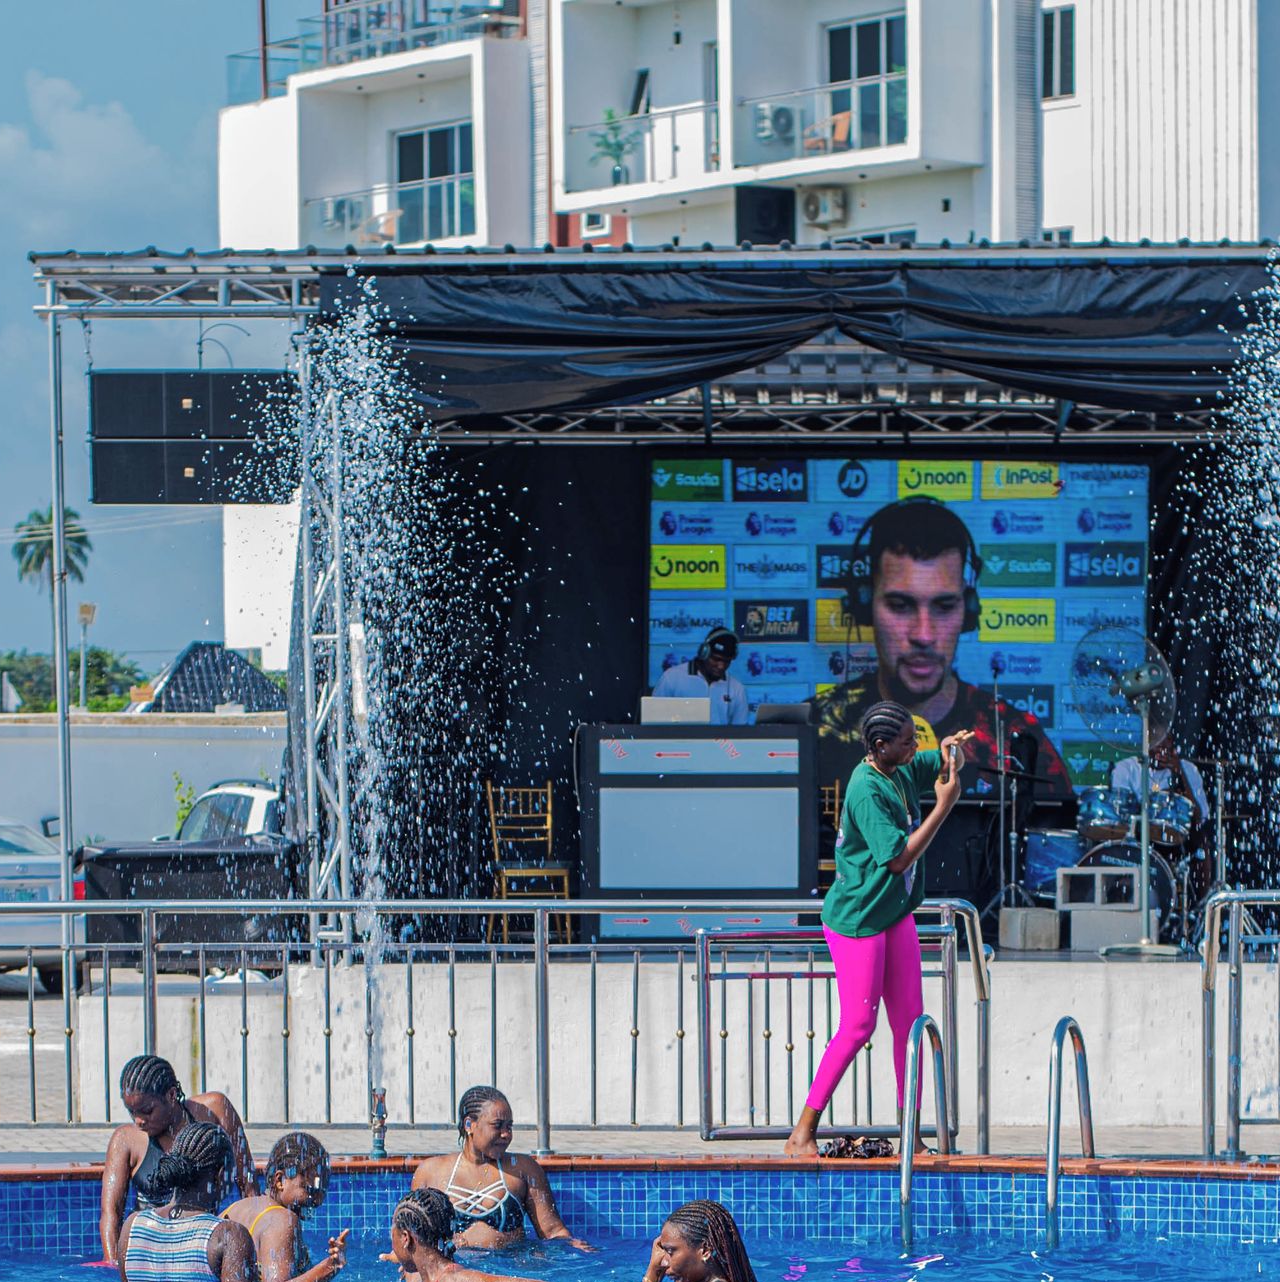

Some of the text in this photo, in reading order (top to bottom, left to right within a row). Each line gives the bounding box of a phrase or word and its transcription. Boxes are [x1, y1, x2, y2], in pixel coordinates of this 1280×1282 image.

[758, 467, 804, 491] sela
[841, 468, 862, 490] JD
[924, 471, 967, 485] noon
[1006, 469, 1053, 484] InPost
[676, 560, 720, 573] noon
[736, 563, 807, 573] THE MAGS
[841, 555, 871, 577] sel
[1091, 553, 1140, 577] sela
[767, 607, 795, 622] BET
[1006, 613, 1048, 626] noon
[651, 618, 724, 628] THE MAGS
[765, 622, 799, 636] MGM
[1006, 695, 1049, 718] ela
